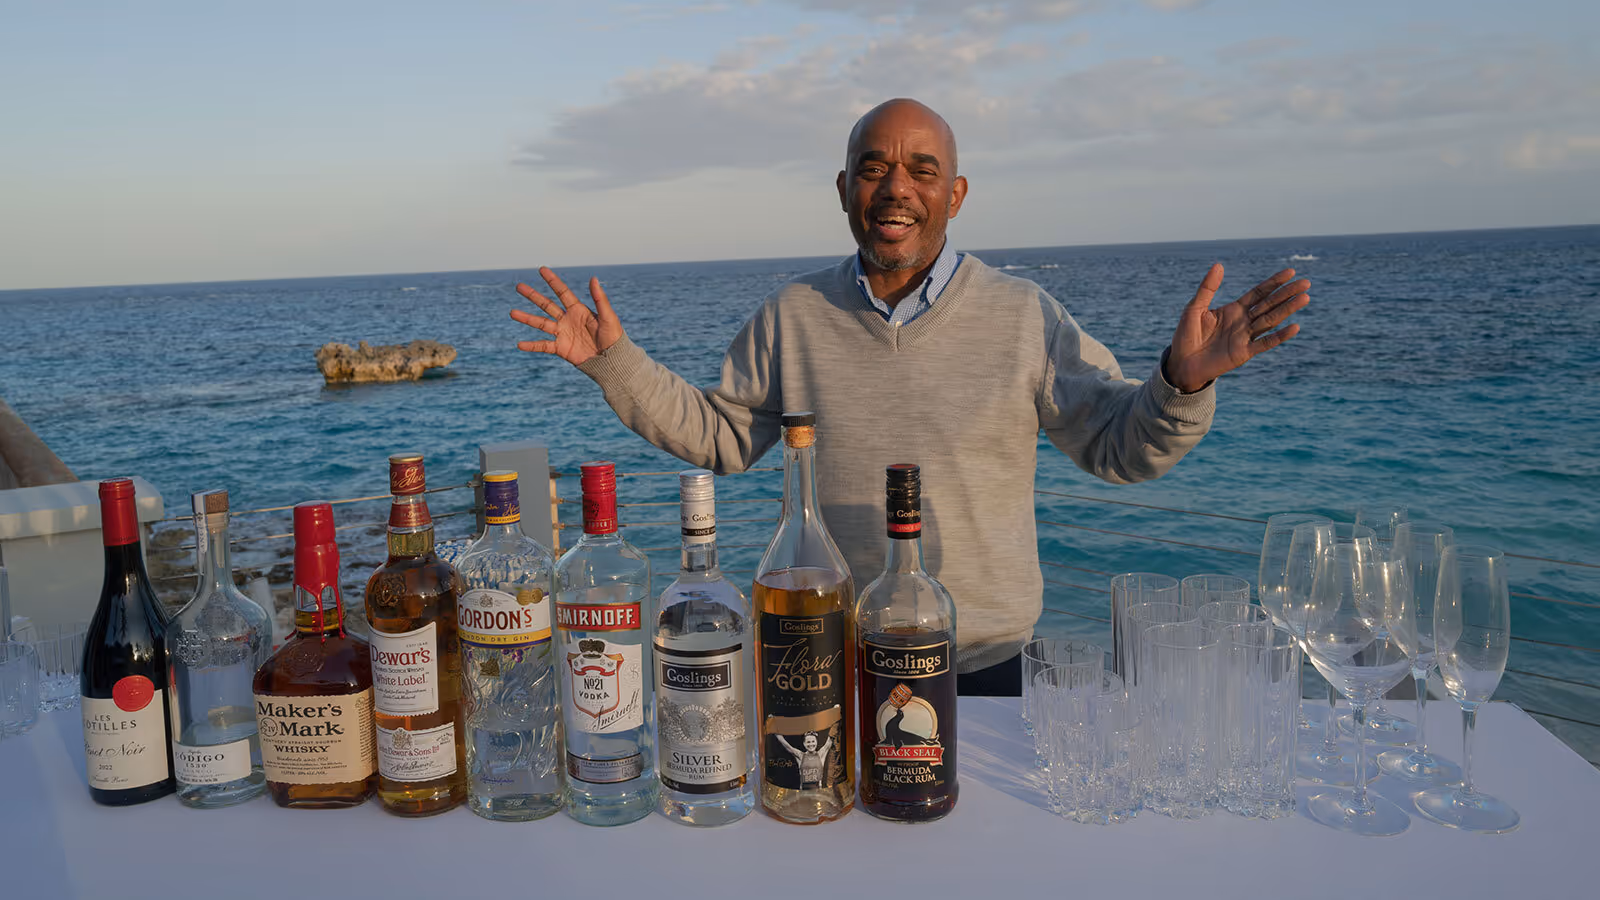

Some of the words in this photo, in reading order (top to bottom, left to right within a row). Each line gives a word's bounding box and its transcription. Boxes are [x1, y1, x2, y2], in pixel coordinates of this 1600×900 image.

[458, 604, 532, 630] GORDON'S
[784, 622, 819, 631] Goslings
[371, 644, 431, 666] Dewar's
[763, 638, 843, 683] Flora
[872, 650, 941, 673] Goslings
[375, 673, 397, 686] White
[397, 673, 426, 686] Label
[666, 668, 722, 687] Goslings
[776, 673, 832, 691] GOLD
[578, 690, 610, 700] VODKA
[257, 701, 343, 718] Maker's
[94, 714, 111, 722] LES
[279, 721, 344, 737] Mark
[274, 744, 330, 753] WHISKY
[414, 747, 432, 757] Sons
[879, 749, 910, 757] BLACK
[913, 749, 937, 757] SEAL
[672, 752, 722, 766] SILVER
[98, 763, 113, 771] 2022
[667, 761, 698, 774] BERMUDA
[700, 763, 732, 774] REFINED
[886, 766, 931, 775] BERMUDA
[883, 774, 914, 784] BLACK
[914, 774, 936, 784] RUM
